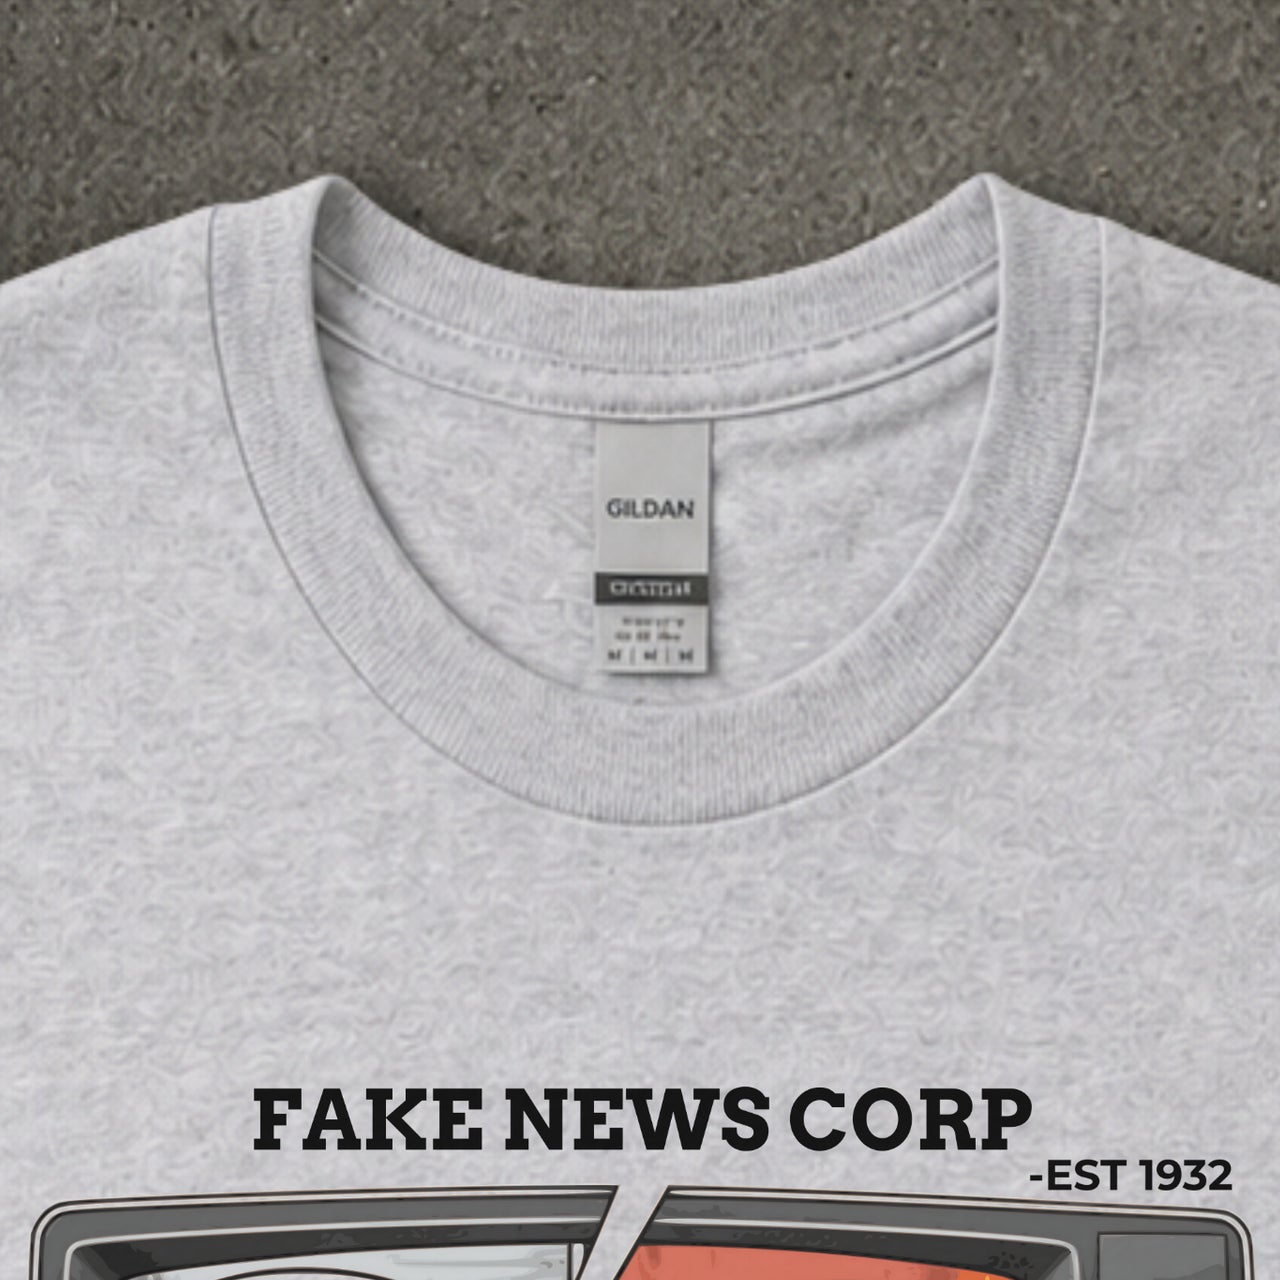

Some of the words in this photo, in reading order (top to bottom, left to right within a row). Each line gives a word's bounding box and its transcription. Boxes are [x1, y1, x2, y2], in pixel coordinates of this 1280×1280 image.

[606, 498, 694, 519] GILDAN
[254, 1087, 482, 1151] FAKE
[506, 1087, 769, 1151] NEWS
[790, 1087, 1032, 1151] CORP
[1030, 1160, 1127, 1190] -EST
[1139, 1160, 1232, 1190] 1932
